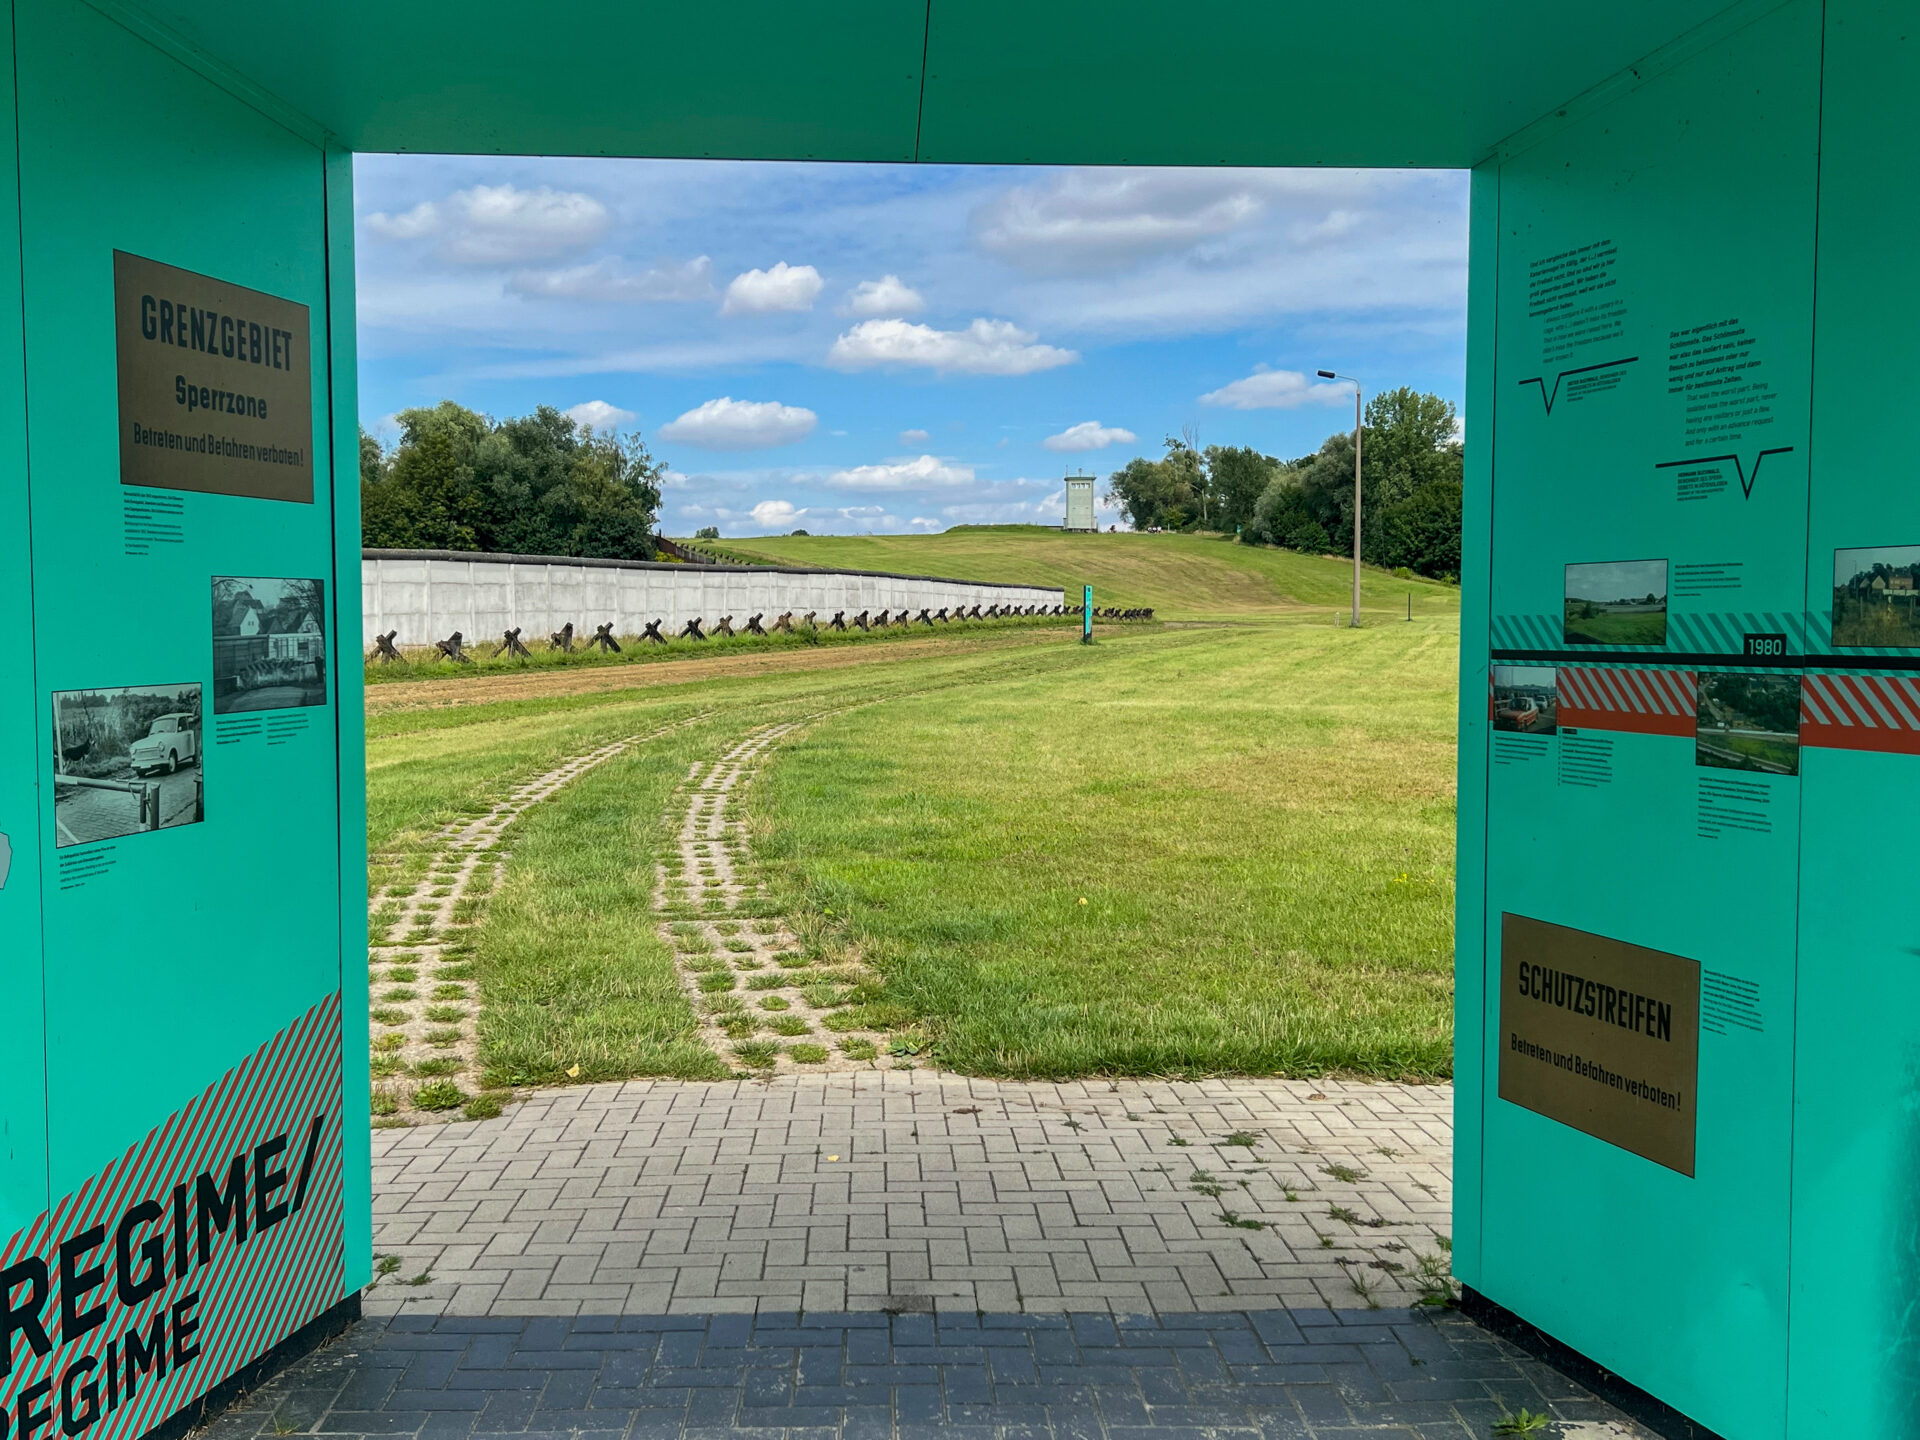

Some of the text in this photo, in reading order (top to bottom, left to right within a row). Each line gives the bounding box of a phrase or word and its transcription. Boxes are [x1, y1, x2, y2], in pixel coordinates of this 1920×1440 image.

[141, 295, 292, 371] GRENZGEBIET
[175, 375, 267, 420] Sperrzone
[134, 422, 182, 451] Betreten
[185, 434, 206, 453] und
[208, 434, 255, 461] Befahren
[1748, 638, 1783, 656] 1980
[1519, 961, 1672, 1042] SCHUTZSTREIFEN
[1511, 1033, 1552, 1065] Betreten
[1553, 1051, 1573, 1072] und
[1575, 1055, 1623, 1091] Befahren
[0, 1290, 200, 1440] EGIME
